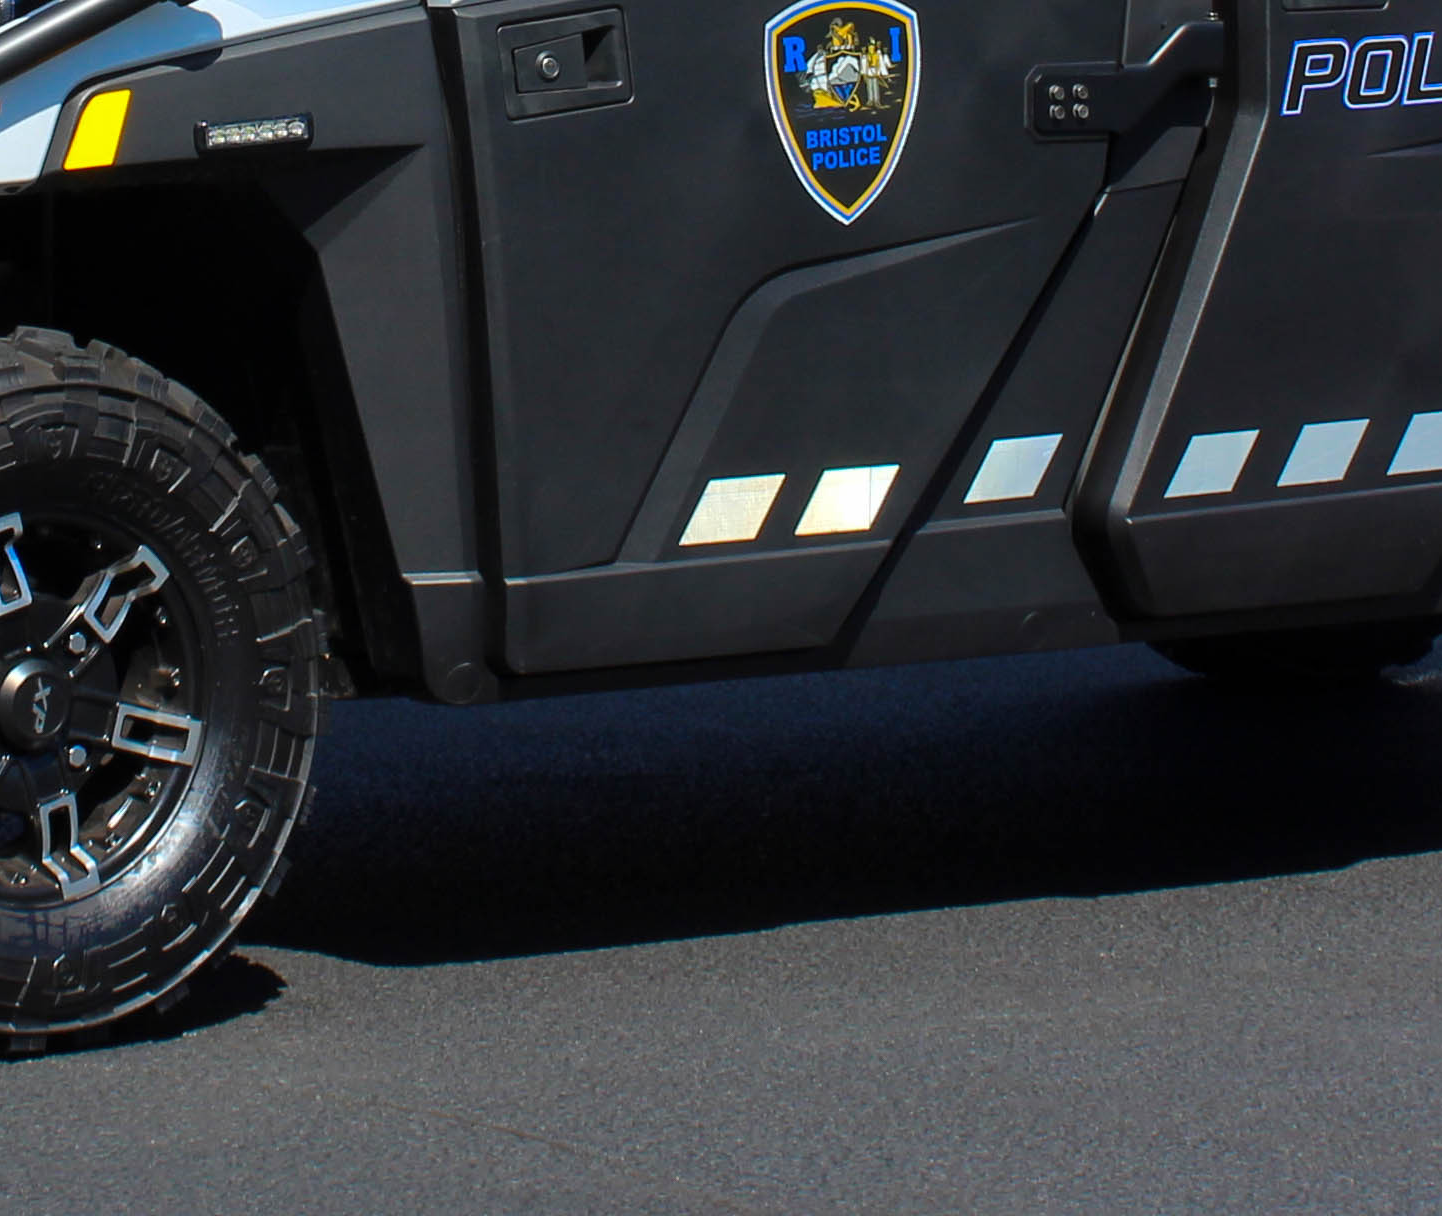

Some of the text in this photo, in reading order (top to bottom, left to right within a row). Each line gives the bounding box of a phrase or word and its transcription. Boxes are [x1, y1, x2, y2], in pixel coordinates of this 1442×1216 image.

[781, 26, 903, 73] R I
[805, 123, 888, 149] BRISTOL
[812, 146, 882, 171] POLICE
